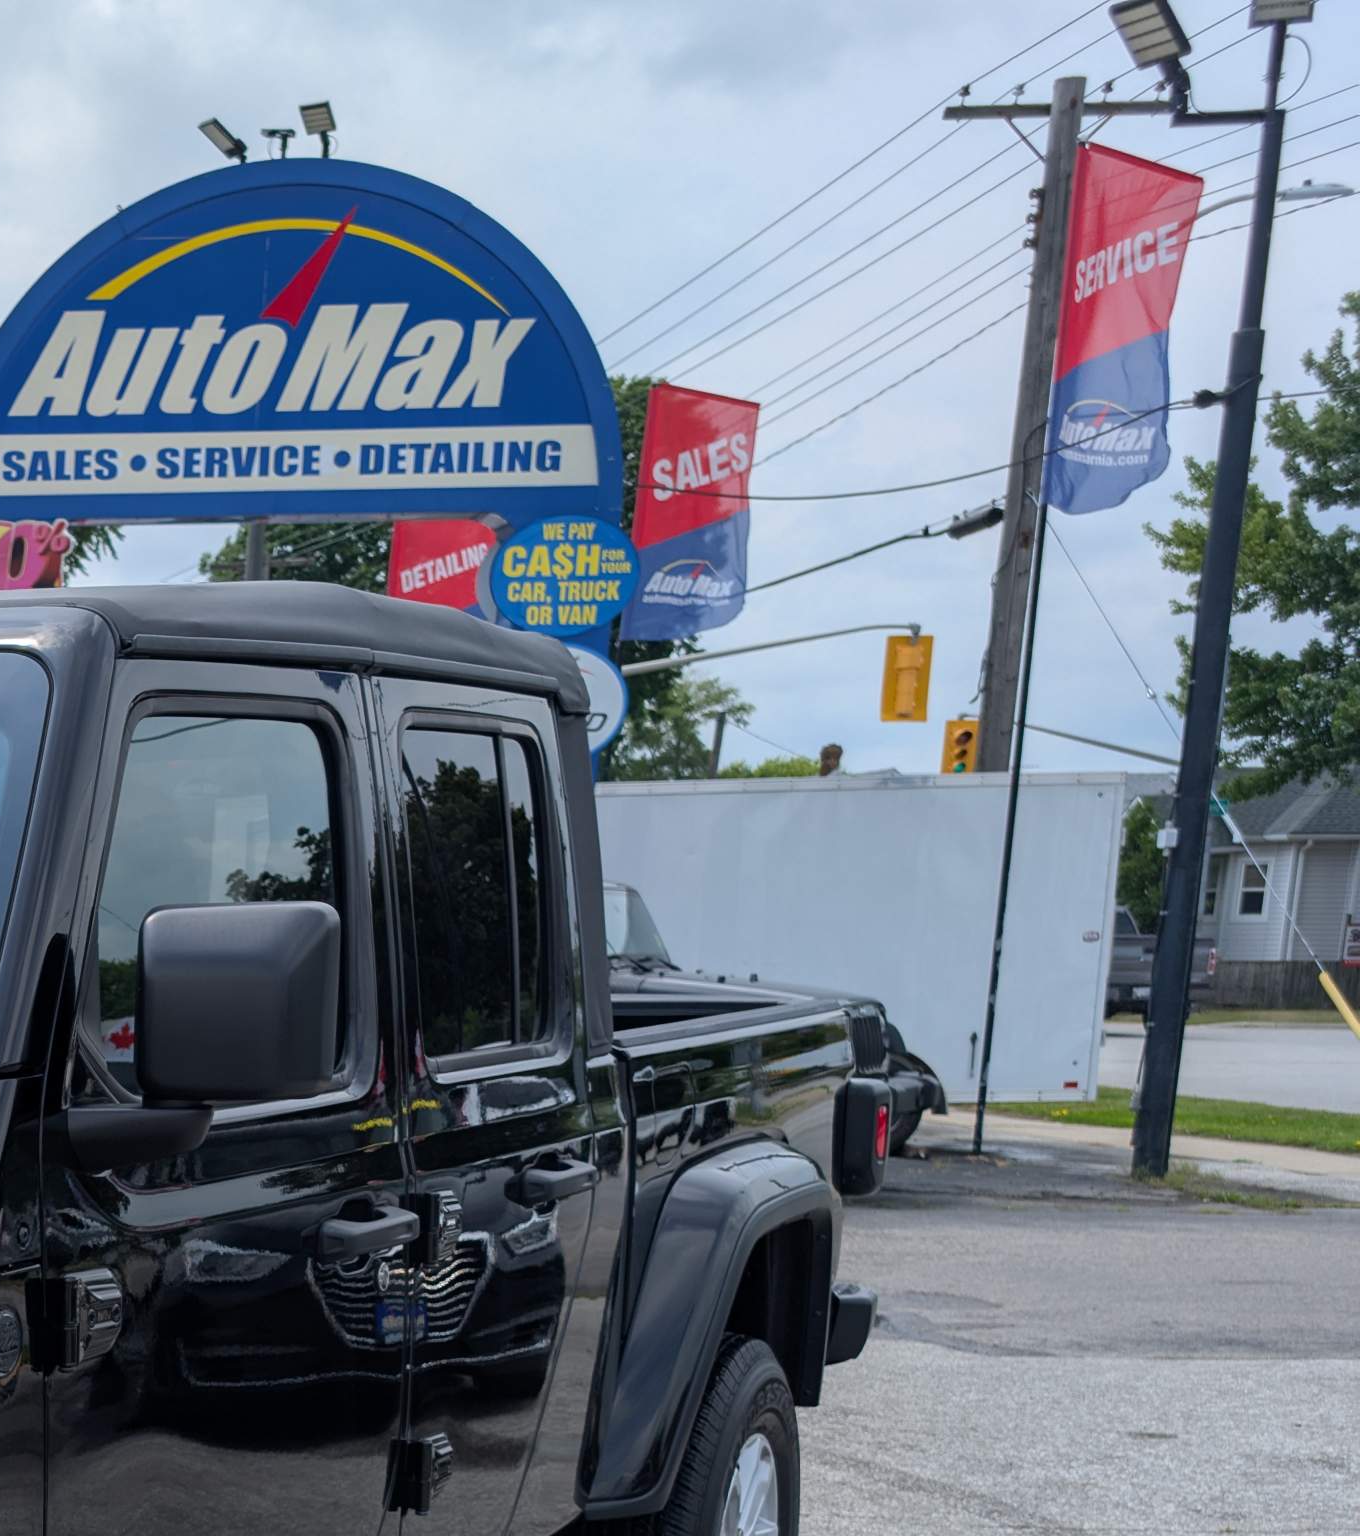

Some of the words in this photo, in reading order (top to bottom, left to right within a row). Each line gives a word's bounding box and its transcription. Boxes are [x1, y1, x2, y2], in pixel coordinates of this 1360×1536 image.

[1075, 221, 1179, 303] SERVICE
[7, 302, 538, 418] AutoMax
[2, 448, 119, 482] SALES
[156, 444, 321, 479] SERVICE
[358, 439, 562, 475] DETAILING
[652, 432, 750, 502] SALES
[543, 523, 565, 541] WE
[568, 522, 597, 541] PAY
[502, 543, 602, 580] CA$H
[601, 562, 632, 574] YOUR
[602, 548, 626, 562] FOR
[508, 581, 553, 604] CAR,
[558, 580, 621, 601] TRUCK
[526, 606, 553, 626] OR
[558, 605, 598, 625] VAN
